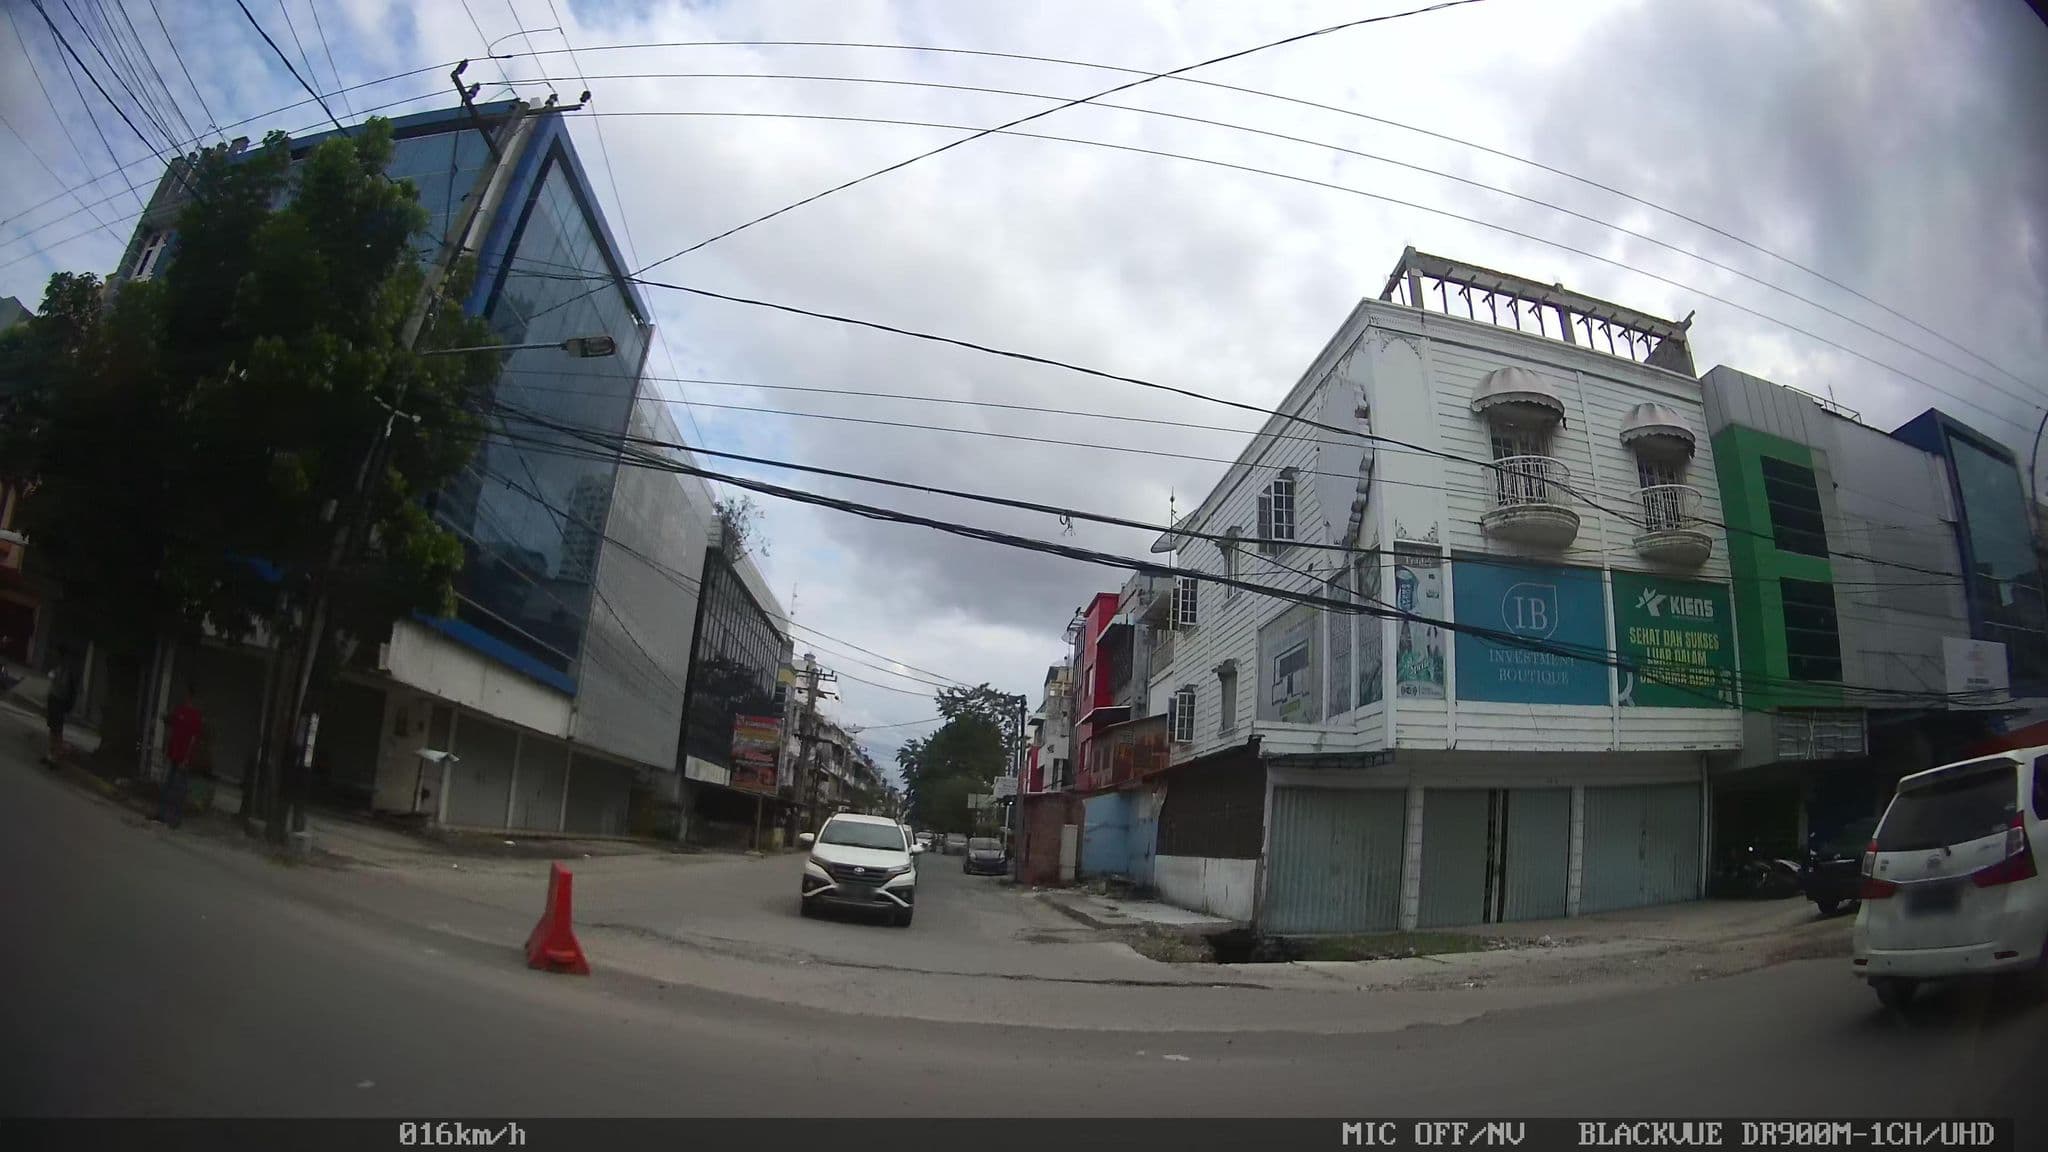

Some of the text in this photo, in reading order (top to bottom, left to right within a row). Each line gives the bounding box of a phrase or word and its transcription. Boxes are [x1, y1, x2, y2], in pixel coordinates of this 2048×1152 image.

[1513, 596, 1548, 630] IB
[1629, 627, 1719, 650] SEHAT DAN SUKSES
[1498, 668, 1569, 685] BOUTIQUE
